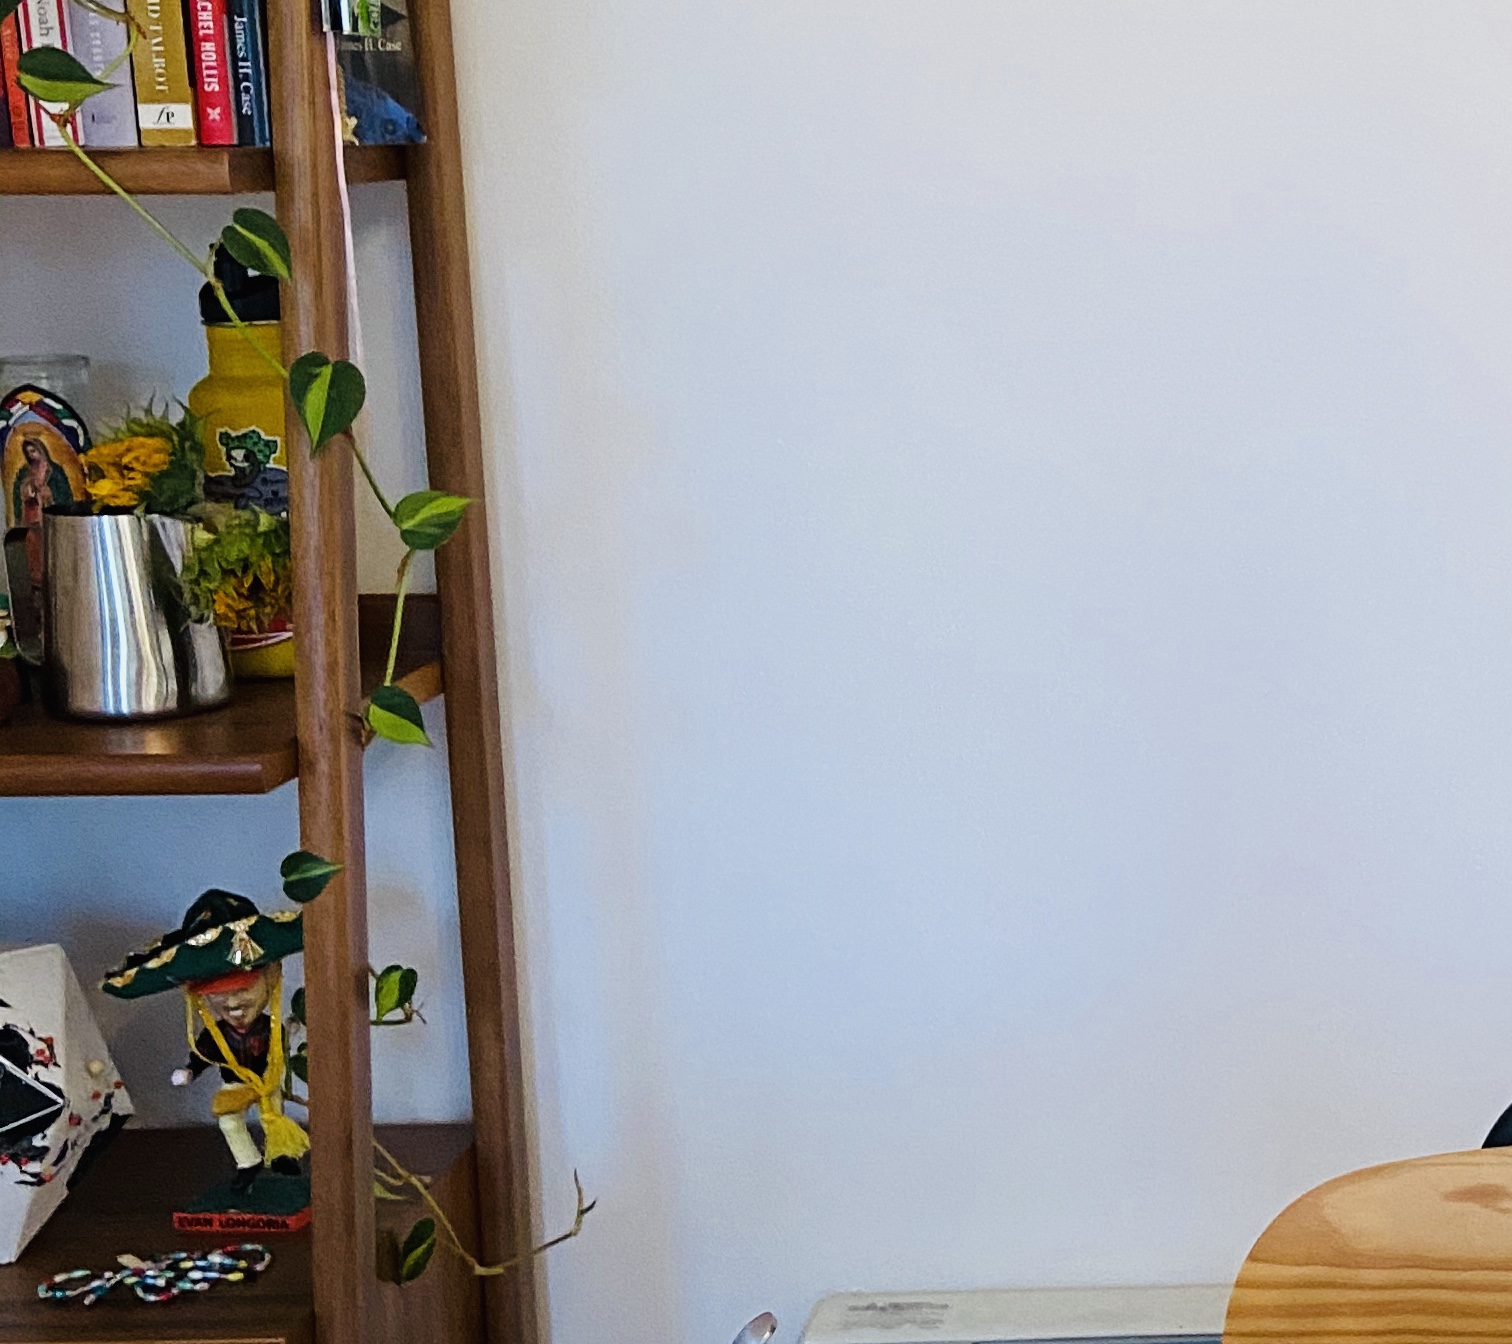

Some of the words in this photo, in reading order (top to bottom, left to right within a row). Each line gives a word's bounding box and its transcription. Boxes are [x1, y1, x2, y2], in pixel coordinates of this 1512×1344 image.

[234, 15, 248, 58] James
[150, 24, 169, 94] TALBOT
[201, 41, 220, 93] HOLLIS
[240, 80, 253, 116] Case
[178, 1215, 213, 1228] EVAN
[218, 1217, 290, 1230] LONGORIA
